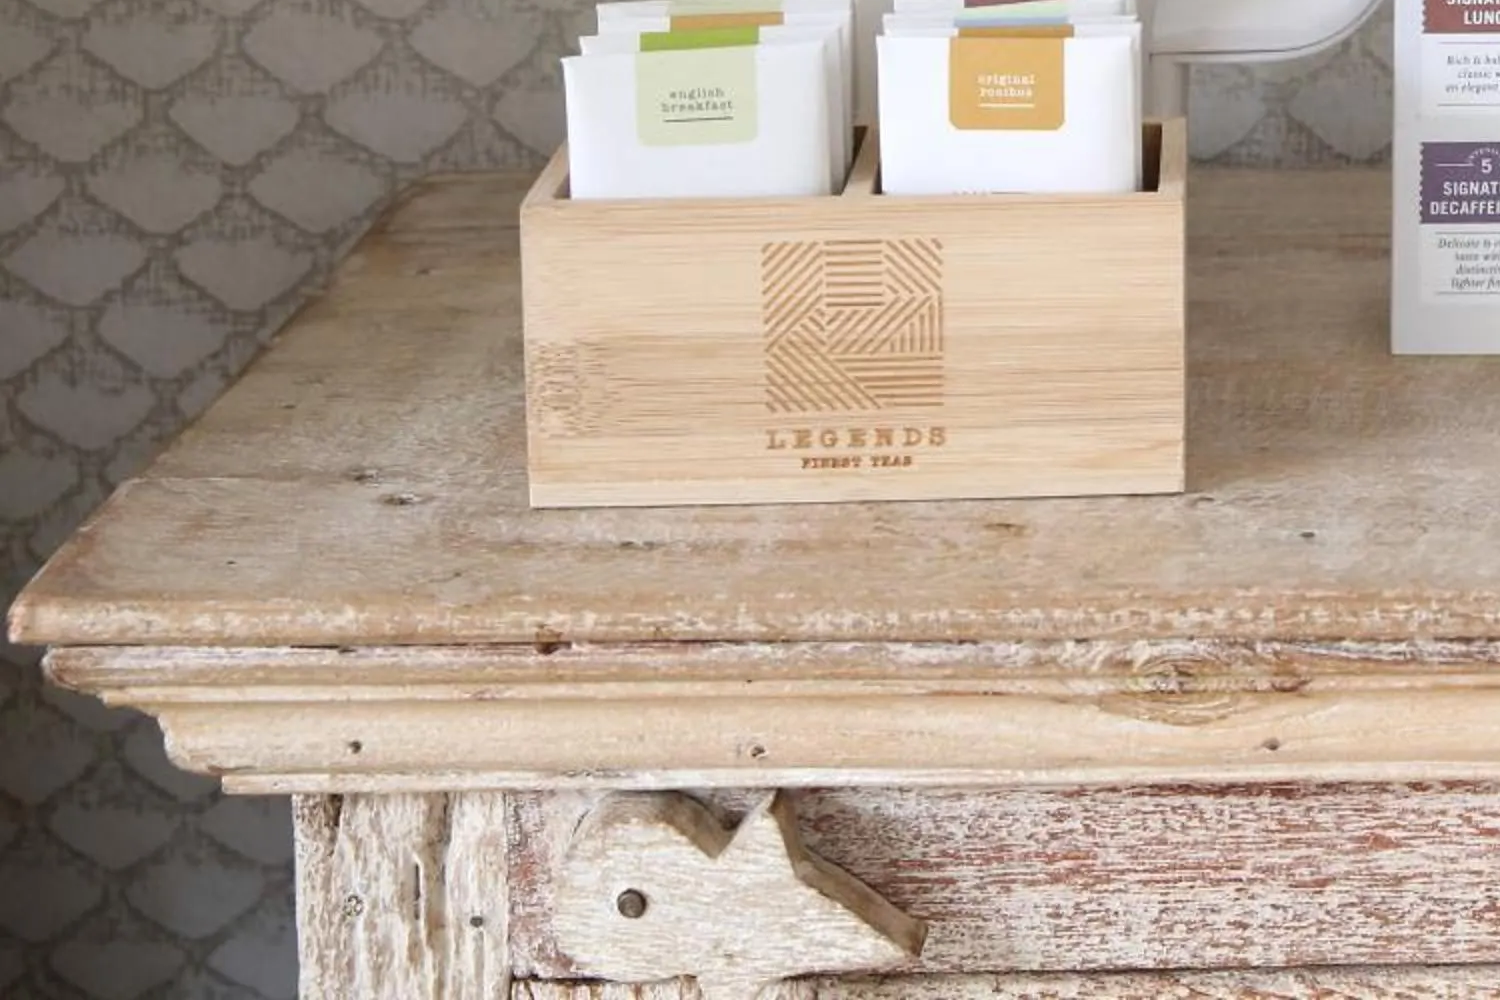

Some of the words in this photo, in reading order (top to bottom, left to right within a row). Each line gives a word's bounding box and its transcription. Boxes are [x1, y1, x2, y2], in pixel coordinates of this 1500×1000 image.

[1447, 55, 1471, 65] Rich
[977, 73, 1035, 86] original
[669, 87, 725, 101] english
[1461, 81, 1498, 95] elegant
[661, 100, 732, 113] breakfast
[1481, 159, 1493, 174] 5
[1438, 238, 1480, 249] Delicate
[766, 427, 946, 450] LEGENDS
[801, 455, 861, 469] FINEST
[869, 455, 913, 467] TEAS
